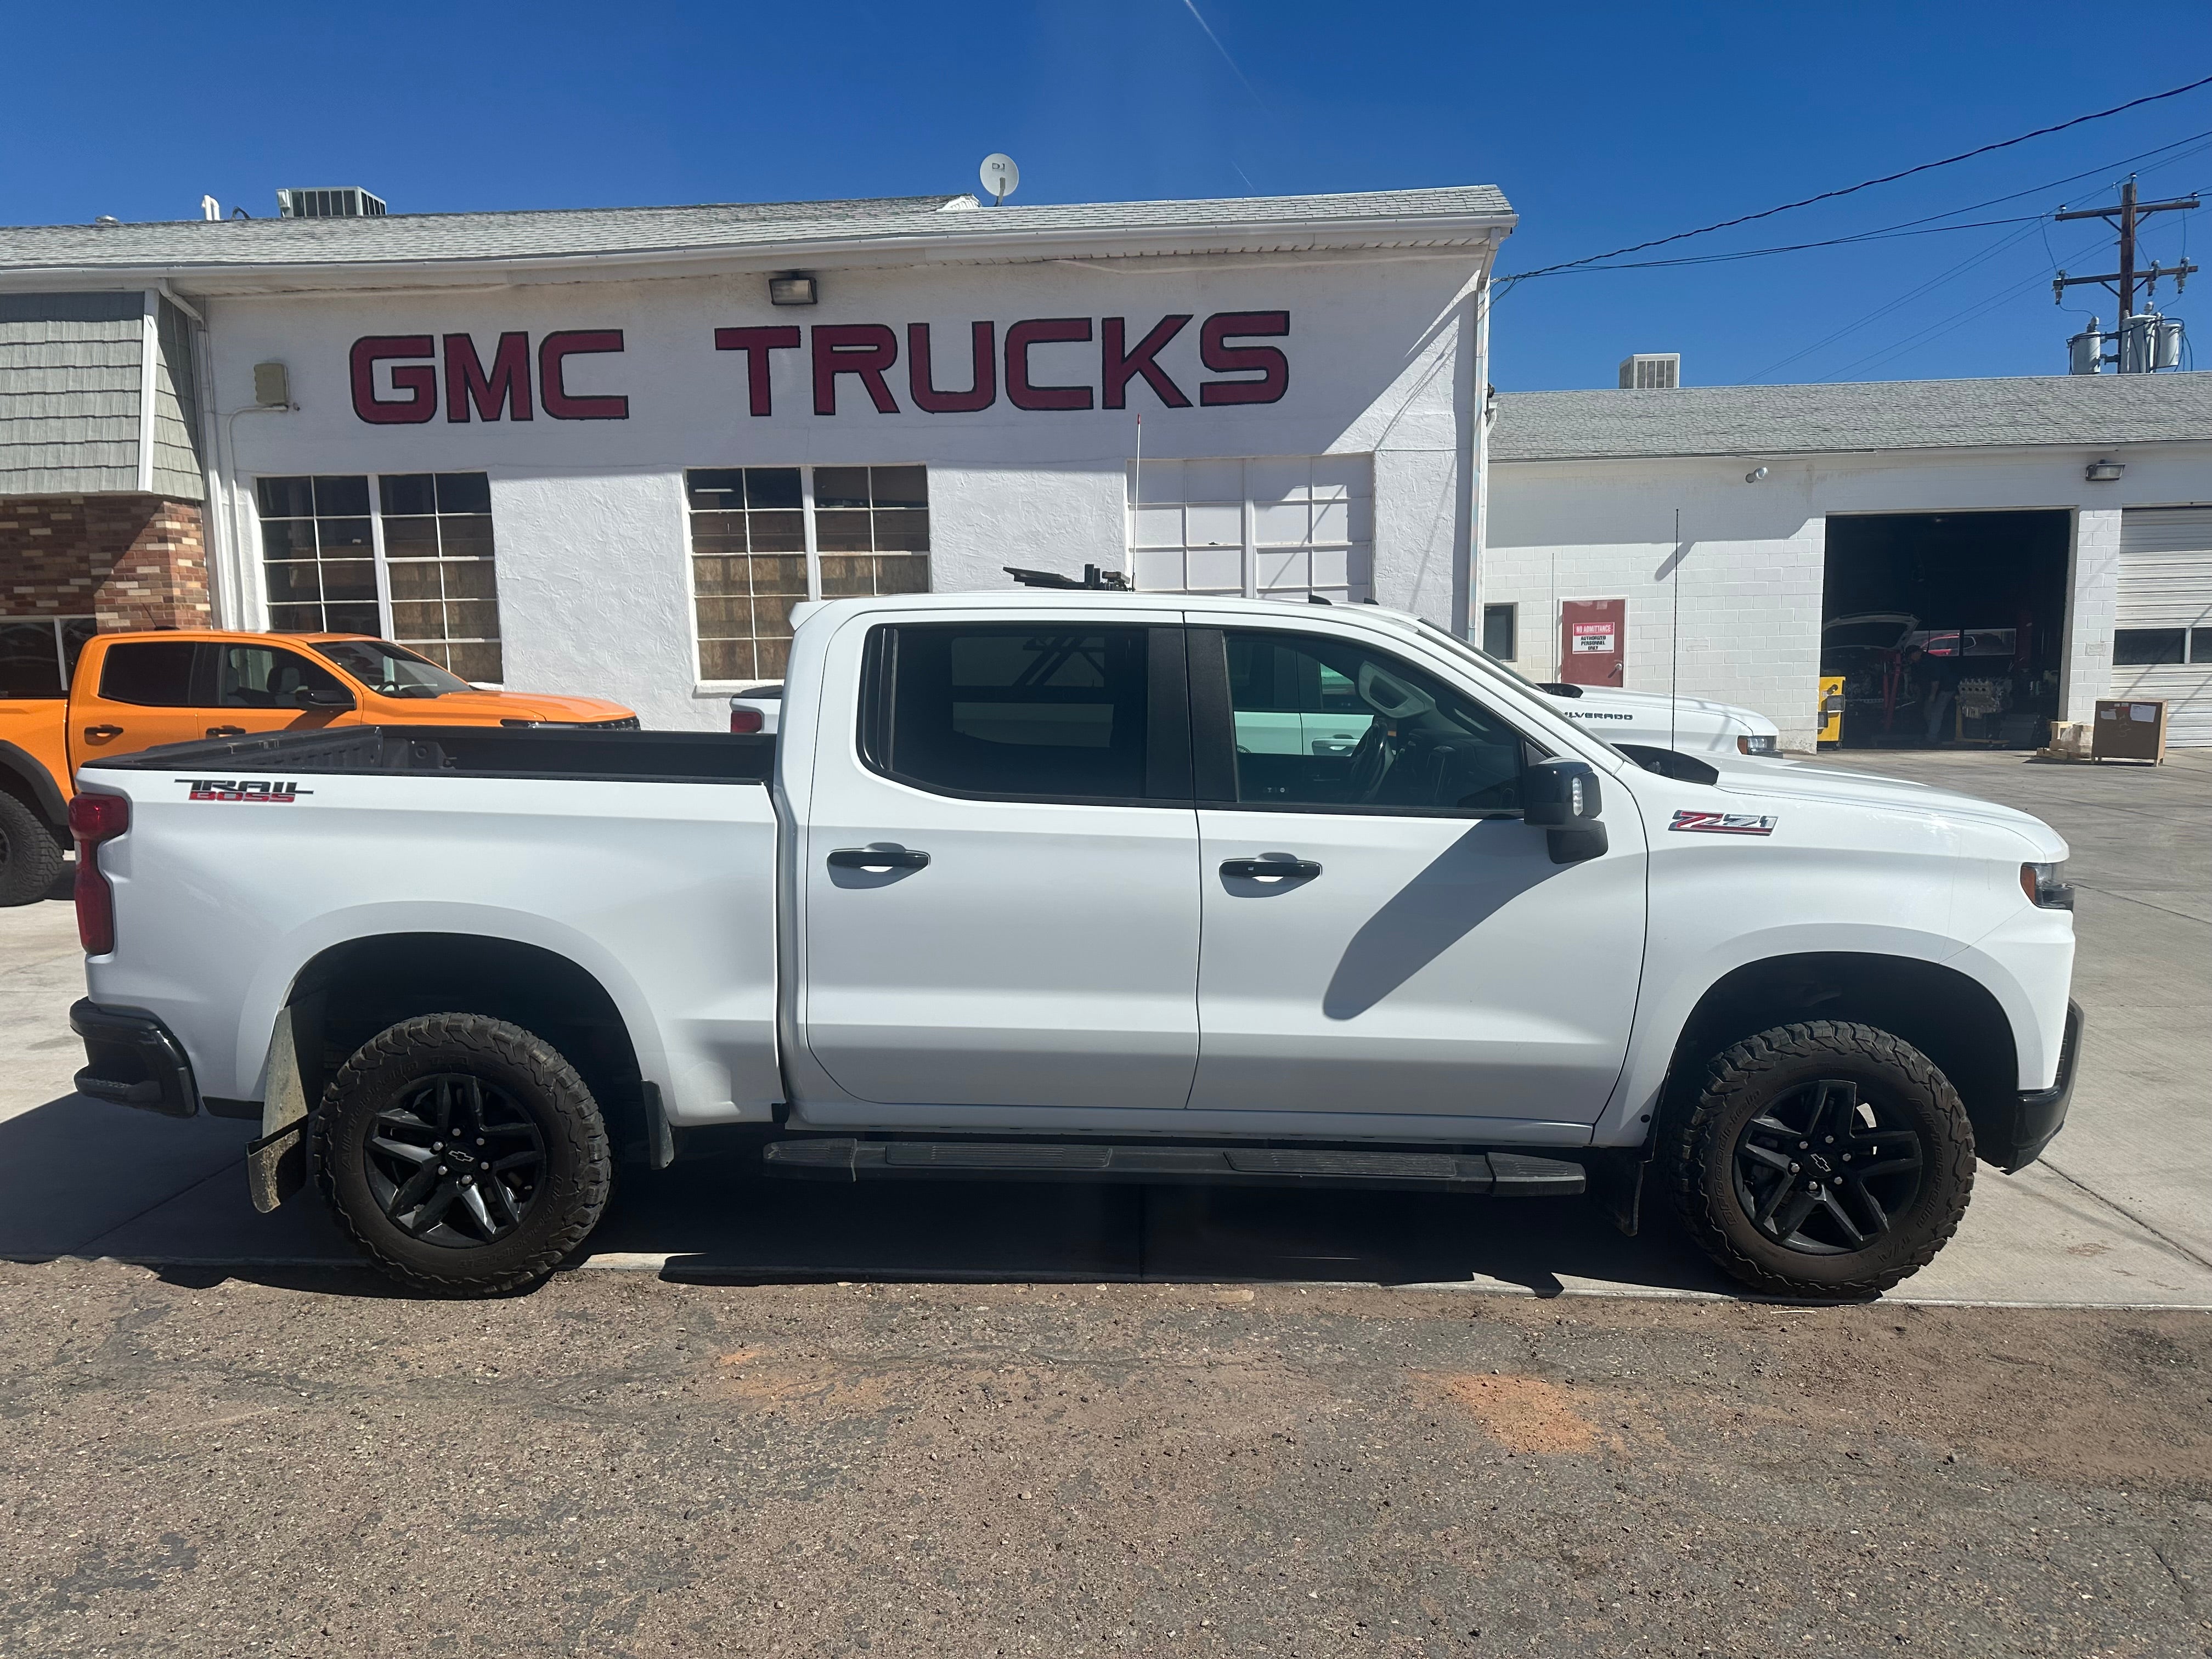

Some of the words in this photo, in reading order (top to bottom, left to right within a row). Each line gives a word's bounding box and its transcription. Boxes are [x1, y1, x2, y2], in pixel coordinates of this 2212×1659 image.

[349, 329, 629, 424] GMC
[715, 311, 1290, 416] TRUCKS
[1583, 624, 1611, 633] ADMITTANCE
[174, 778, 314, 794] TRAIL
[189, 791, 296, 803] BOSS
[1668, 809, 1779, 837] Z71
